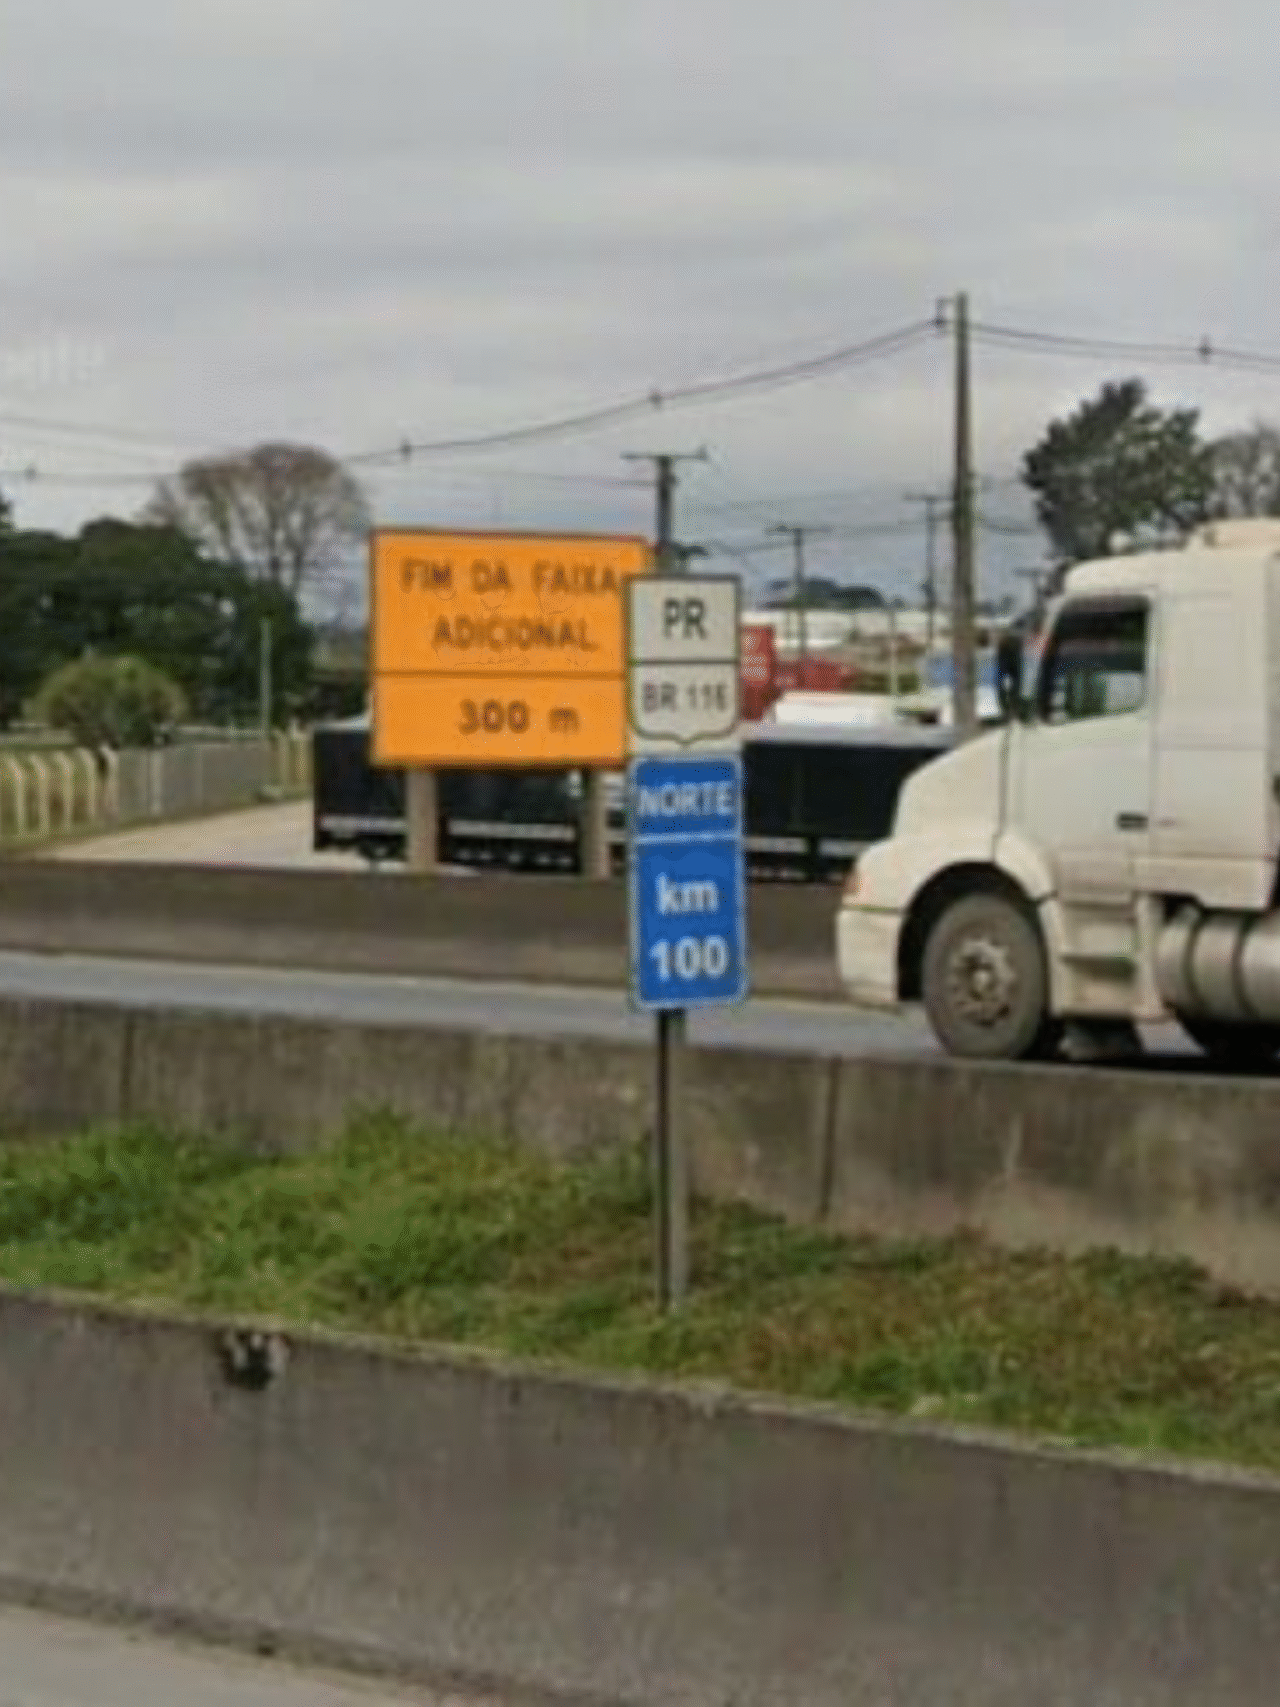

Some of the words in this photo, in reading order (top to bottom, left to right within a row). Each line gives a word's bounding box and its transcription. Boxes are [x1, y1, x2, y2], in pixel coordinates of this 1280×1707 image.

[402, 557, 453, 592] FIM
[470, 559, 513, 594] DA
[531, 560, 620, 595] FAIXA
[432, 614, 600, 652] ADICIONAL
[663, 597, 708, 642] PR
[458, 699, 531, 734] 300
[548, 706, 581, 733] m
[642, 681, 679, 714] BR
[637, 781, 734, 818] NORTE
[655, 870, 719, 916] km
[648, 935, 730, 984] 100
